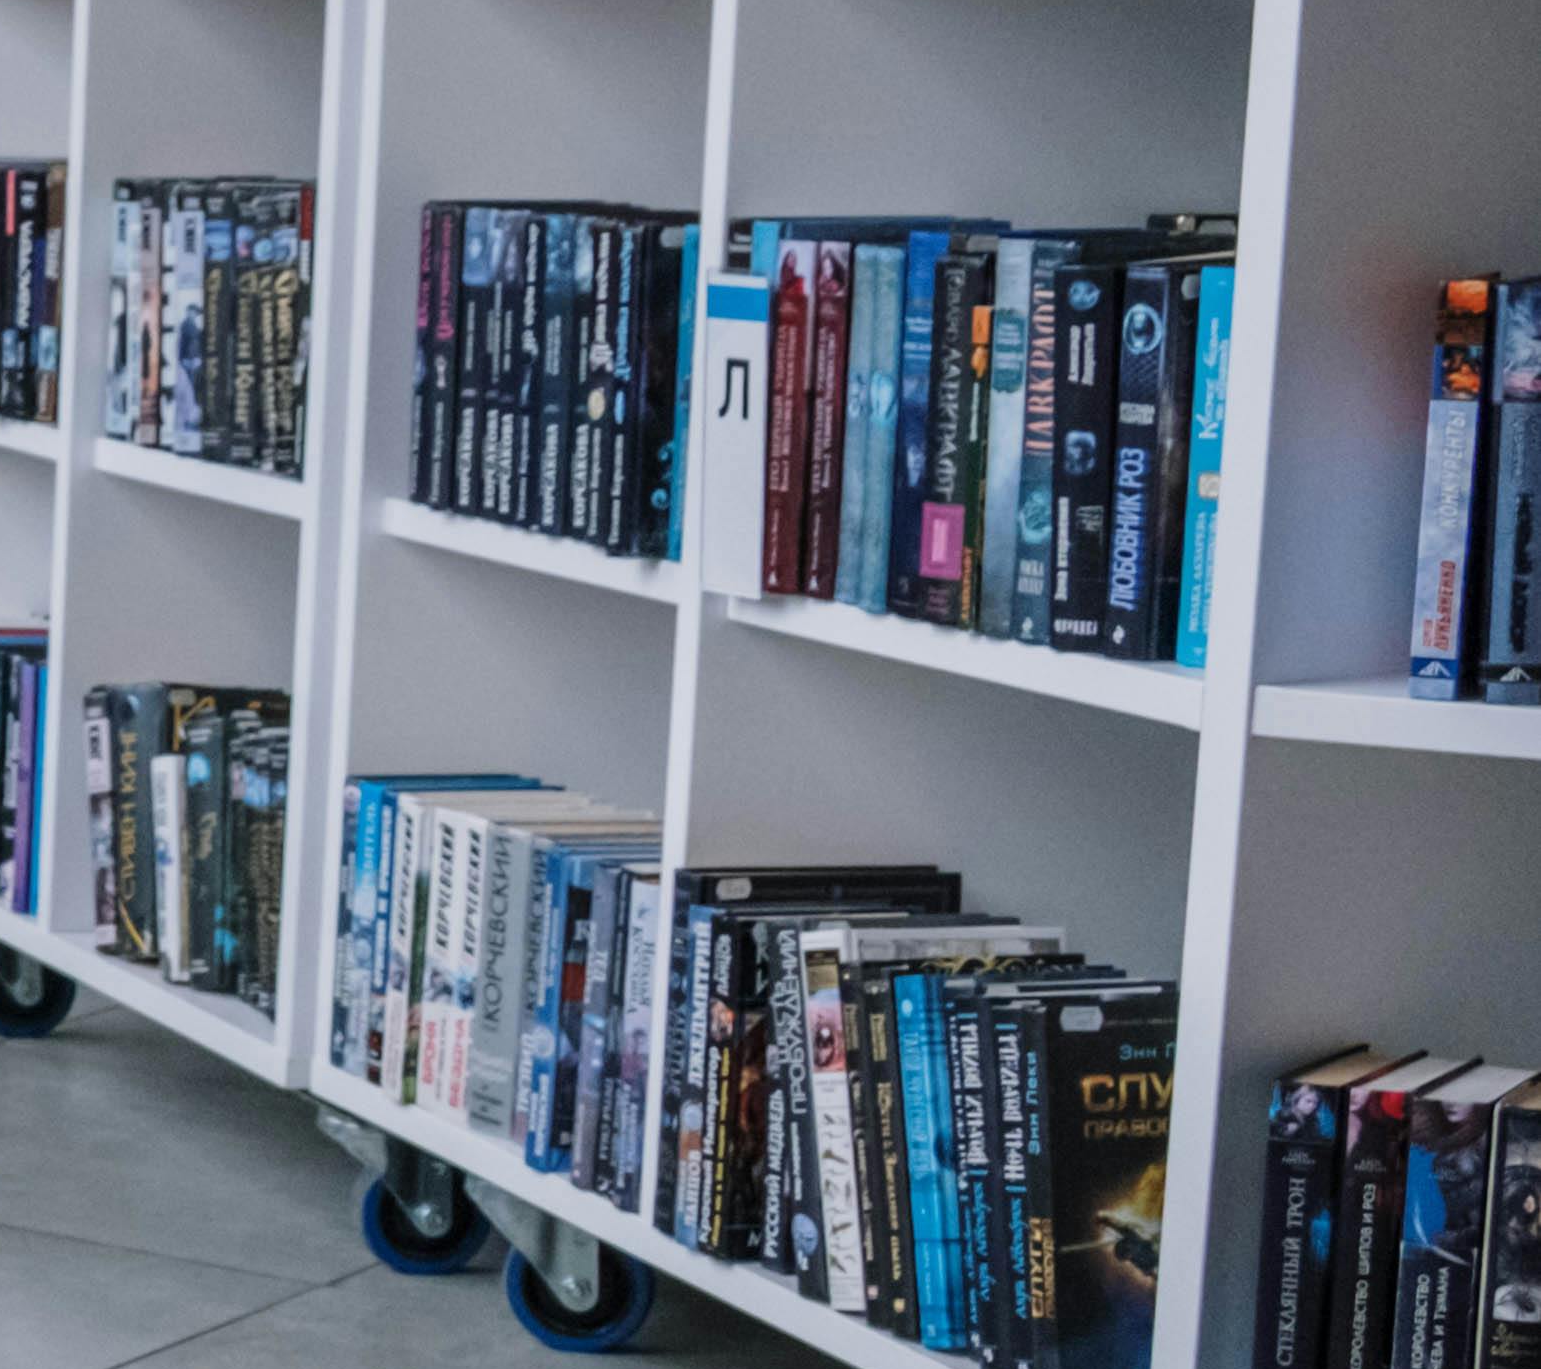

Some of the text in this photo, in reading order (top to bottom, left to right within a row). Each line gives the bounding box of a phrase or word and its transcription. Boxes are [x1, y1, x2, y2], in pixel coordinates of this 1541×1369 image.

[718, 358, 750, 421] Л
[1024, 282, 1056, 457] ЛАВКРАФТ
[457, 407, 475, 506] КОРСАКОВА
[483, 409, 500, 509] КОРСАКОВА
[497, 413, 514, 514] КОРСАКОВА
[541, 424, 559, 526] КОРСАКОВА
[935, 347, 963, 502] ЛАВКРАФТ
[1119, 446, 1146, 489] РОЗ
[1438, 410, 1466, 529] КОНКУРЕНТЫ
[572, 424, 589, 528] КОРСАКОВА
[1109, 492, 1144, 611] ЛЮБОВНИК
[1433, 560, 1456, 651] ЛУКЬЯНЕНКО
[396, 809, 413, 939] КОРЧЕВСКИЙ
[433, 822, 455, 950] КОРЧЕВСКИЙ
[461, 827, 482, 958] КОРЧЕВСКИЙ
[482, 835, 513, 1023] КОРЧЕВСКИЙ
[523, 848, 547, 1012] КОРЧЕВСКИЙ
[716, 934, 733, 996] ЛАНЦОВ
[778, 929, 808, 1115] ПРОБУЖДЕНИЙ
[1119, 1043, 1156, 1061] Энн
[1026, 1051, 1042, 1155] Энн Леки
[1081, 1072, 1174, 1112] СЛУ
[1083, 1116, 1170, 1140] ПРАВО
[683, 1149, 702, 1230] ЛАНЦОВ
[698, 1046, 721, 1244] Красный Император
[764, 1089, 784, 1259] РУССКИЙ МЕДВЕДЬ
[1359, 1213, 1374, 1224] И
[1361, 1182, 1377, 1211] РОЗ
[1029, 1217, 1043, 1319] СЛУГИ
[1274, 1177, 1306, 1367] СТЕКЛЯННЫЙ ТРОН
[1356, 1226, 1374, 1276] ШИПОВ
[1433, 1266, 1450, 1321] ТУМАНА
[1410, 1274, 1429, 1369] КОРОЛЕВСТВО
[1432, 1324, 1444, 1336] И
